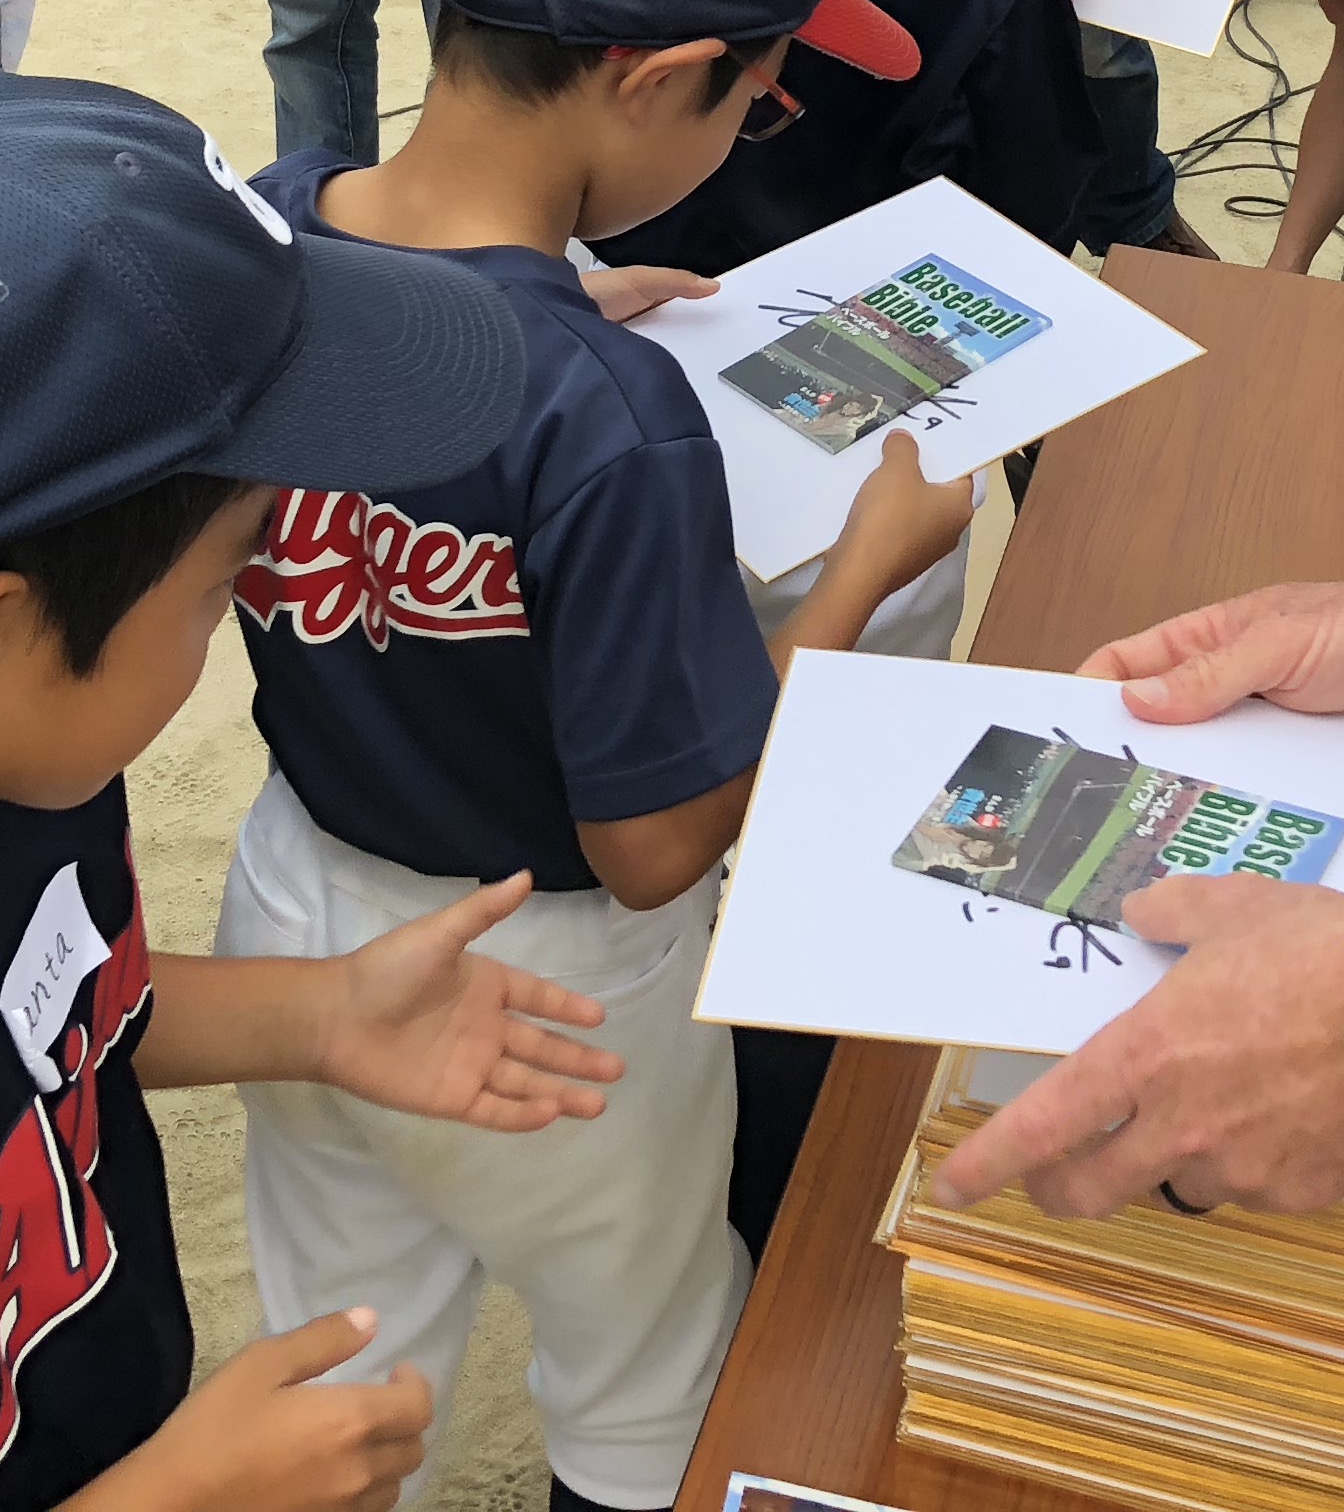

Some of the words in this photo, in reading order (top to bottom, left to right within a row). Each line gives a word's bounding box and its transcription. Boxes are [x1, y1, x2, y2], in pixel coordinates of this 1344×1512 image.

[860, 283, 939, 334] Bible
[899, 261, 1031, 339] Baseball
[1161, 790, 1259, 868] Bible
